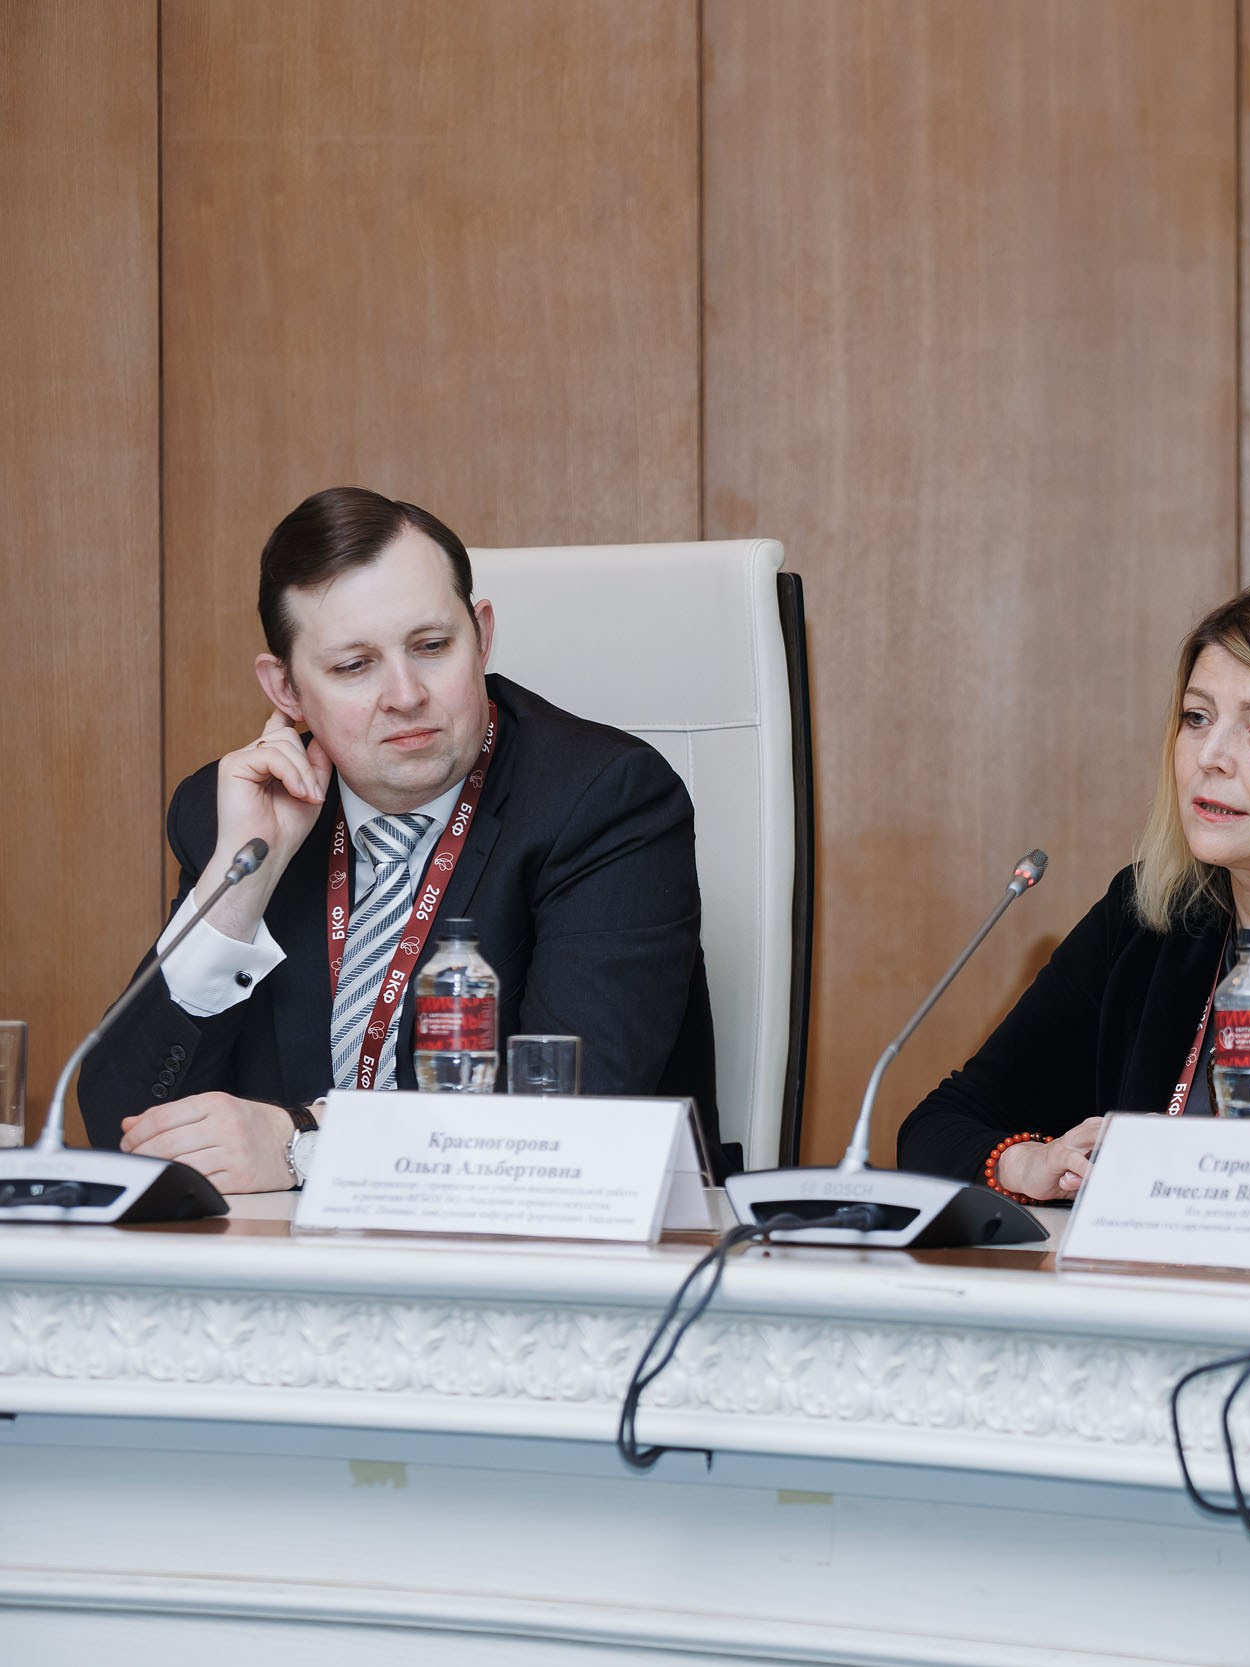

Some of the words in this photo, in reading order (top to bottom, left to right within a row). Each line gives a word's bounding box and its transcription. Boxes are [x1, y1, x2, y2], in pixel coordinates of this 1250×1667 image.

[451, 802, 473, 837] БКФ
[333, 820, 345, 855] 2026
[415, 885, 441, 922] 2026
[331, 906, 345, 941] БКФ
[382, 969, 407, 1005] БКФ
[360, 1055, 376, 1091] БКФ
[1168, 1083, 1187, 1116] БКФ
[427, 1132, 561, 1154] Красногорова
[394, 1157, 452, 1176] Ольга
[458, 1159, 583, 1181] Альбертовна
[823, 1183, 874, 1196] BOSCH
[1150, 1181, 1231, 1201] Вячеслав
